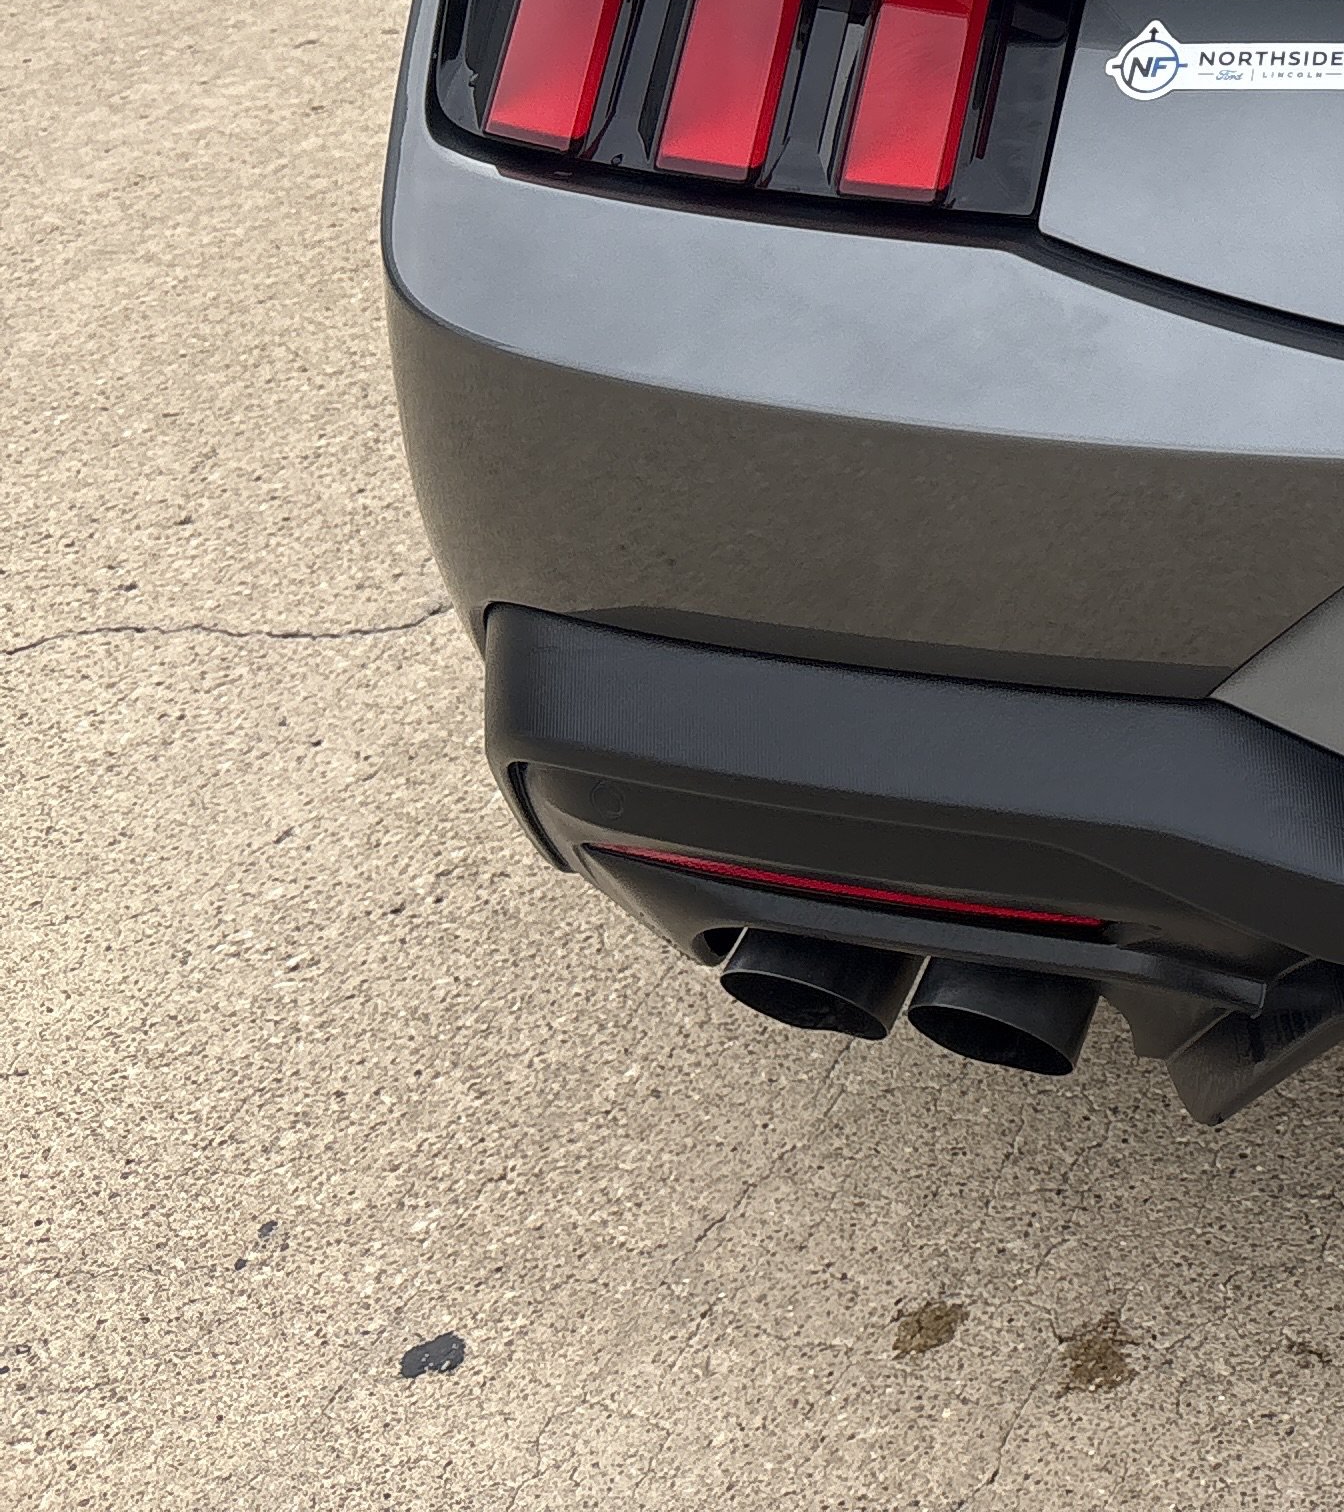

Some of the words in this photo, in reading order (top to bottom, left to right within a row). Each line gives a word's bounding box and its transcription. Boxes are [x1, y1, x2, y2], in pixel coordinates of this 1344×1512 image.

[1127, 56, 1176, 86] NF
[1198, 51, 1344, 67] NORTHSIDE
[1215, 69, 1243, 81] Ford
